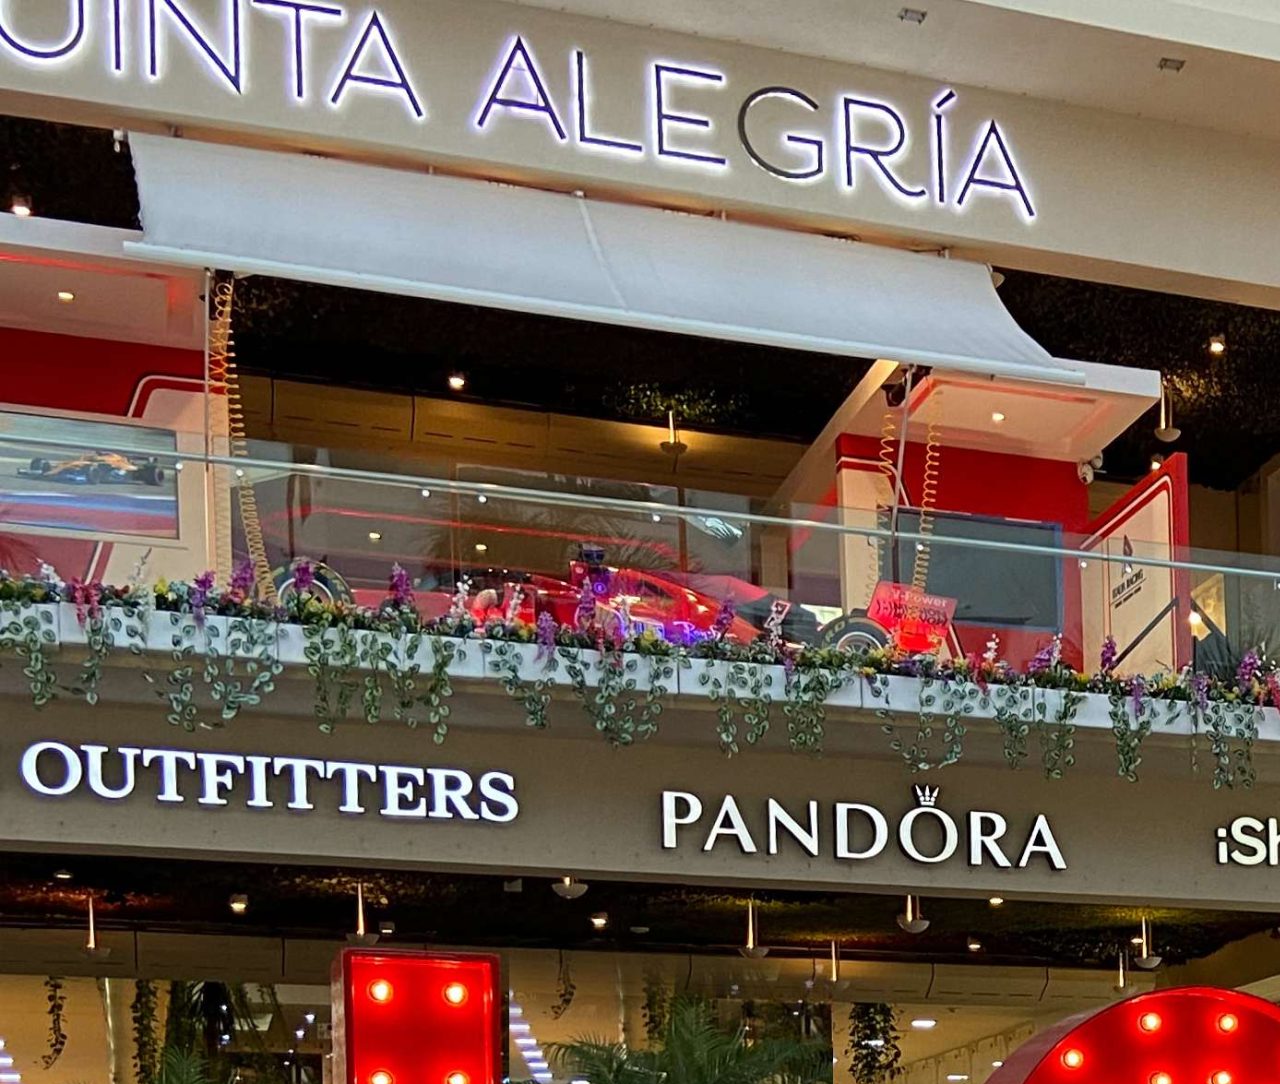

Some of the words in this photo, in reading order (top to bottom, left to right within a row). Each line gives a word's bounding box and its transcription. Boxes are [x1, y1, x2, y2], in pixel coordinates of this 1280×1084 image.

[477, 34, 1036, 218] ALEGRÍA
[20, 740, 519, 822] OUTFITTERS
[661, 784, 1067, 869] PANDORA
